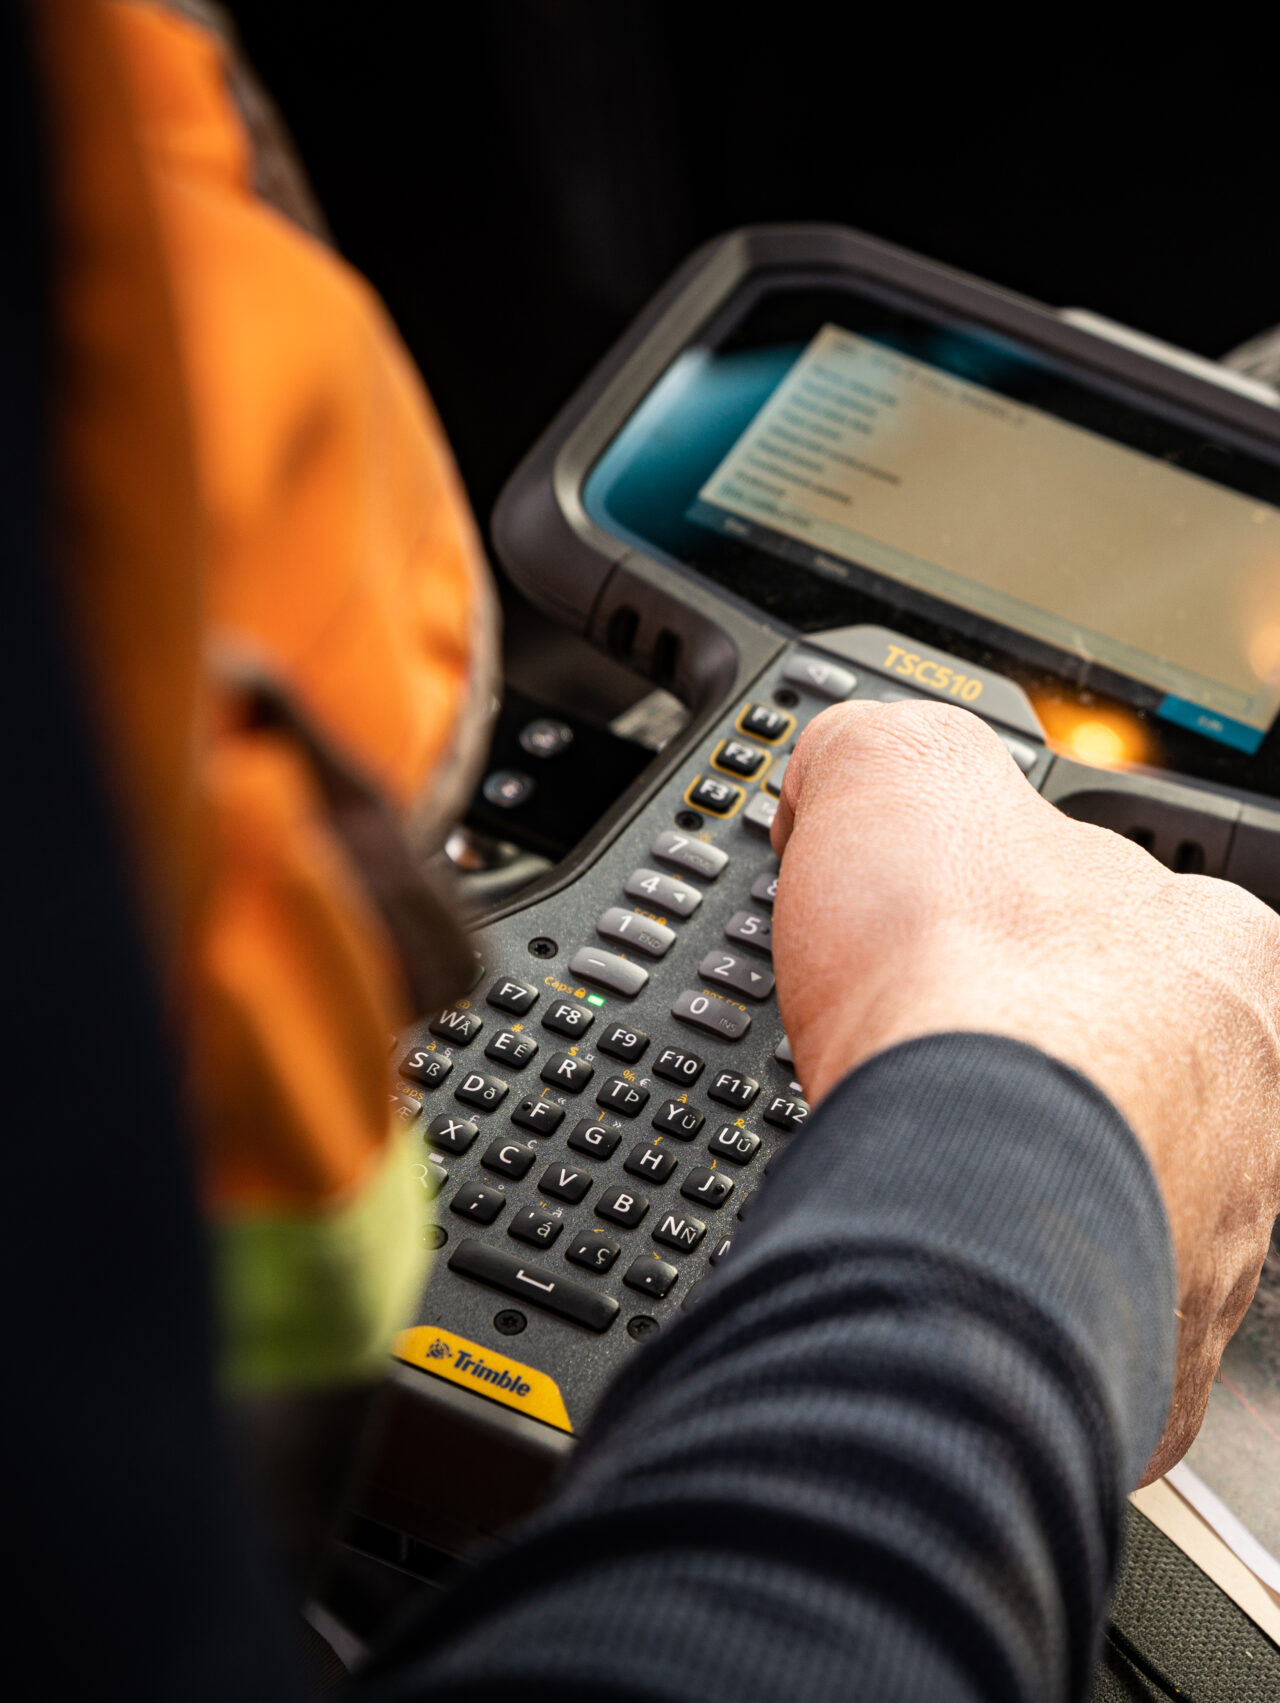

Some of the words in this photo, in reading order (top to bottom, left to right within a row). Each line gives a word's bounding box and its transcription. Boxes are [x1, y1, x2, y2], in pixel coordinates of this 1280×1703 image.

[883, 644, 984, 702] TSC510
[751, 706, 780, 728] F1
[725, 741, 753, 765] F2
[699, 779, 729, 801] F3
[668, 836, 689, 854] 7
[640, 876, 661, 894] 4
[618, 915, 634, 933] 1
[638, 932, 661, 949] END
[739, 916, 761, 935] 5
[713, 956, 736, 976] 2
[499, 982, 528, 1000] F7
[544, 976, 573, 994] Caps
[555, 1005, 582, 1025] F8
[689, 996, 710, 1015] 0
[719, 1017, 737, 1032] INS
[611, 1028, 637, 1048] F9
[557, 1059, 578, 1080] R
[659, 1050, 698, 1075] F10
[716, 1074, 753, 1100] F11
[530, 1102, 550, 1118] F
[770, 1098, 808, 1124] F12
[439, 1119, 464, 1141] X
[584, 1126, 606, 1145] G
[499, 1146, 520, 1164] C
[639, 1150, 664, 1170] H
[559, 1168, 578, 1187] V
[698, 1175, 716, 1192] J
[612, 1194, 635, 1213] B
[454, 1350, 530, 1396] Trimble
